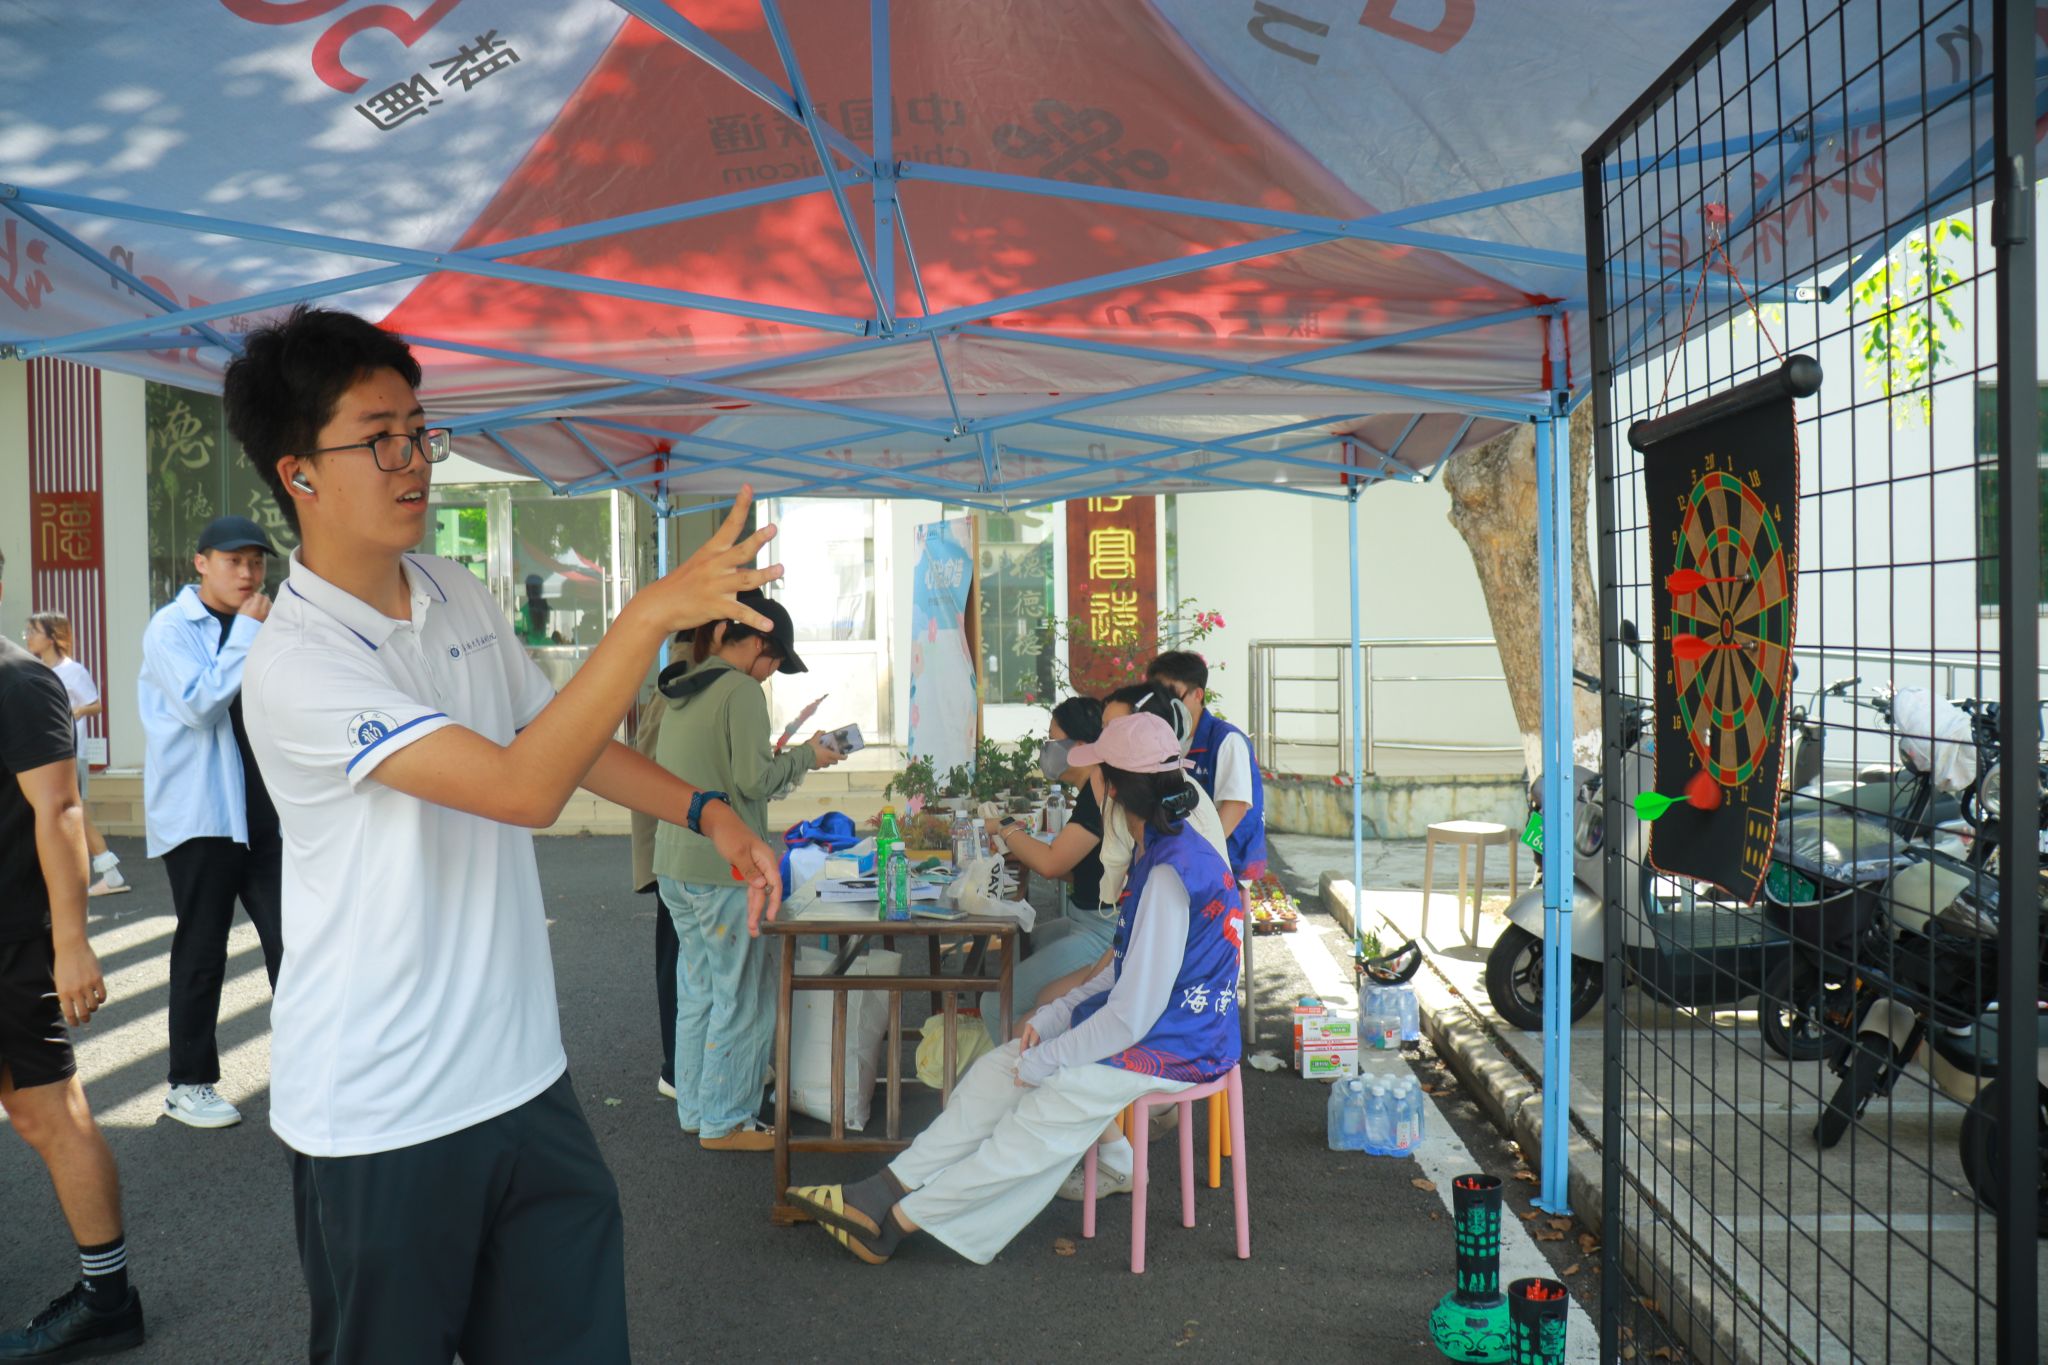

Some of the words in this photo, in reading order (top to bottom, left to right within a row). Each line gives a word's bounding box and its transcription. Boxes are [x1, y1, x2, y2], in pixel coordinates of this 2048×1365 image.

[1704, 453, 1715, 471] 20
[1727, 455, 1733, 472] 1
[1748, 469, 1761, 488] 18
[1774, 503, 1782, 522] 4
[1672, 530, 1678, 546] 9
[1663, 625, 1671, 641] 11
[1672, 715, 1682, 730] 16
[1689, 752, 1695, 768] 7
